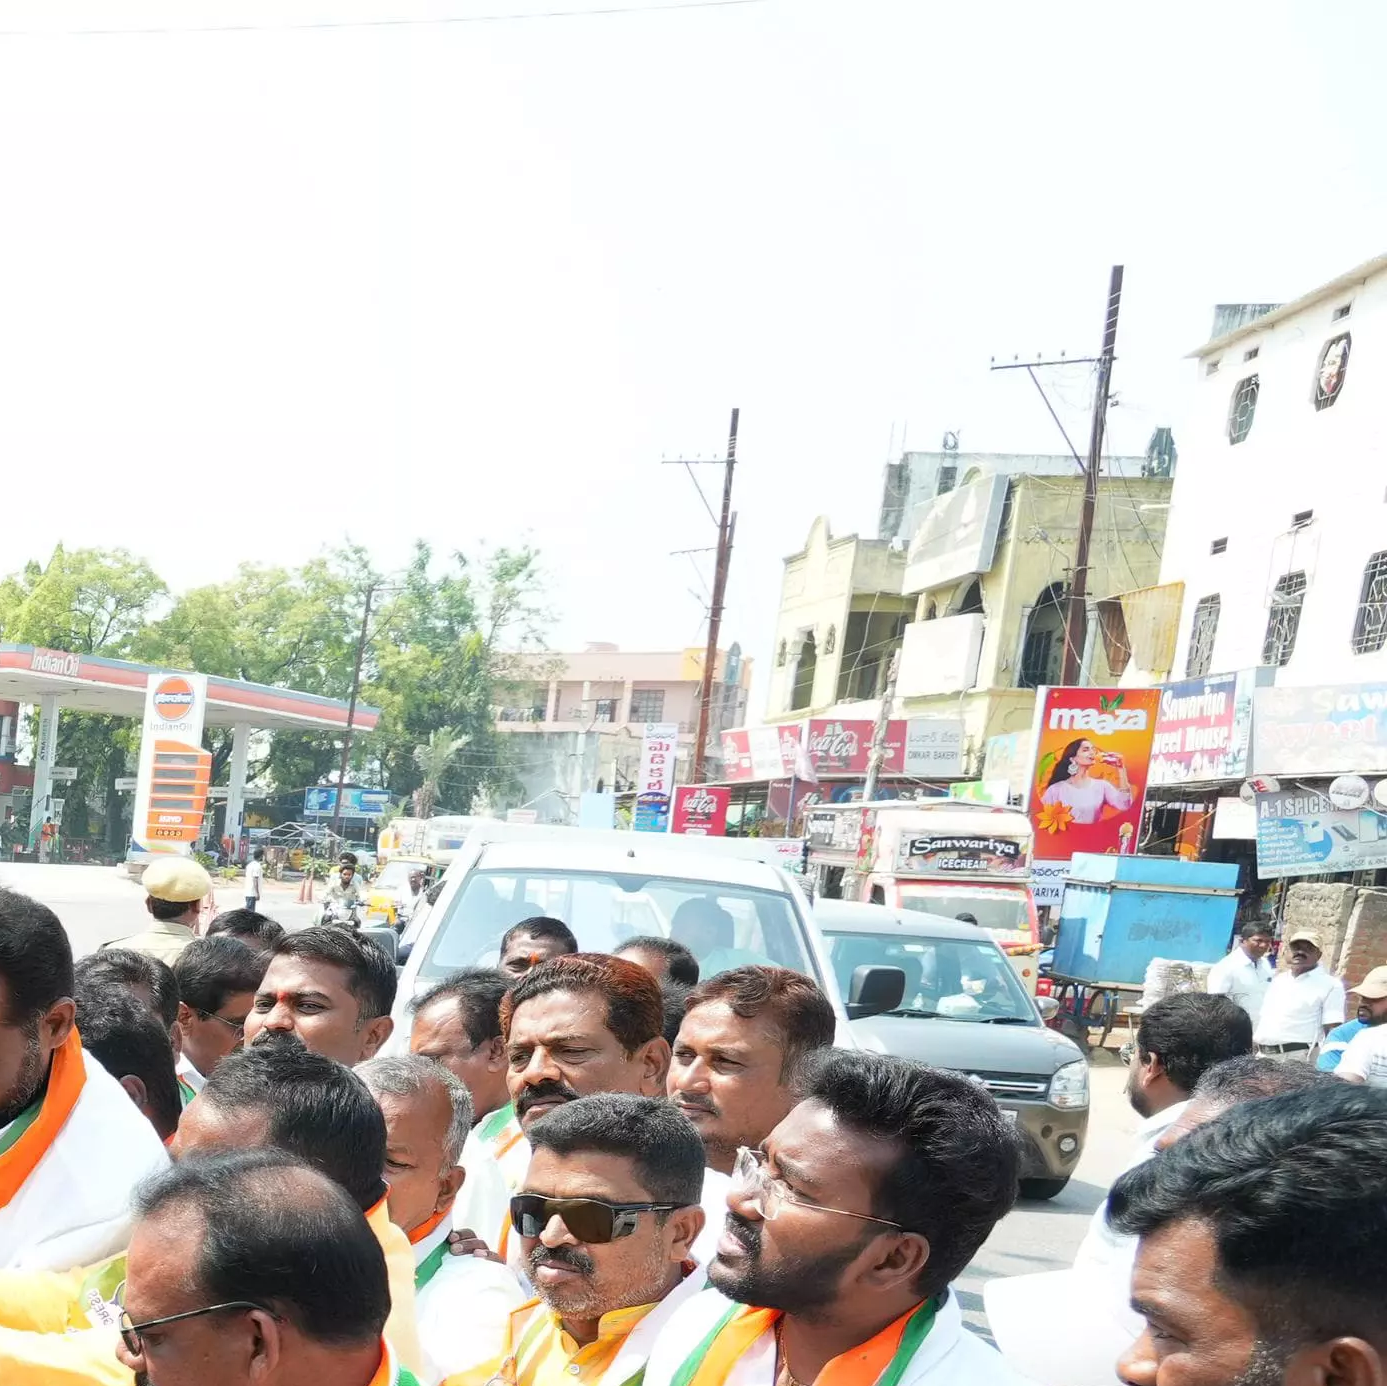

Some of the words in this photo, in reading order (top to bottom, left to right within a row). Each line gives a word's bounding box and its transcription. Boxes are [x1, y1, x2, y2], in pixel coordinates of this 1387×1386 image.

[31, 653, 80, 678] IndianOil
[151, 721, 193, 732] IndianOil
[1050, 708, 1147, 736] maaza
[933, 749, 961, 762] BAKERY
[1261, 799, 1282, 818] A-1
[911, 837, 1016, 859] Sanwariya
[938, 858, 987, 871] ICECREAM
